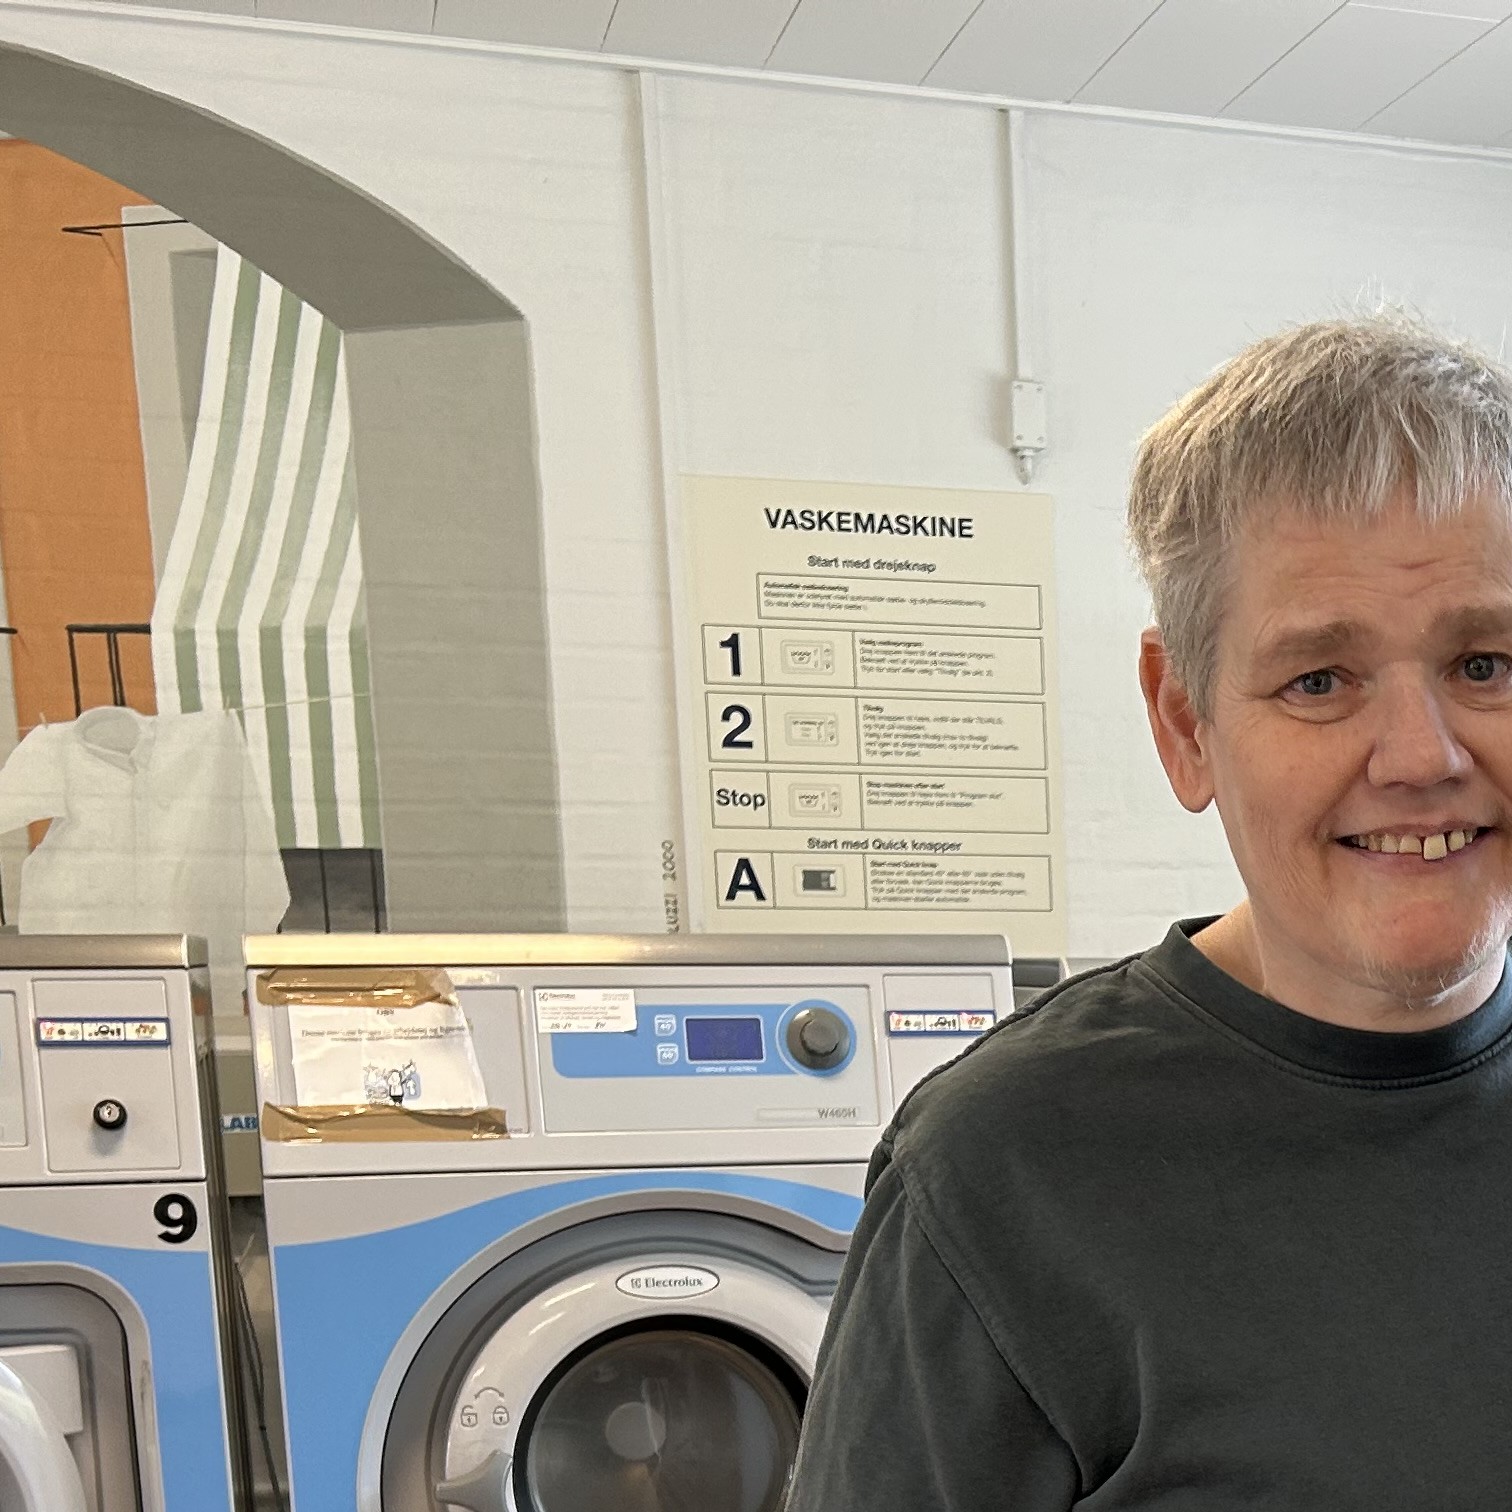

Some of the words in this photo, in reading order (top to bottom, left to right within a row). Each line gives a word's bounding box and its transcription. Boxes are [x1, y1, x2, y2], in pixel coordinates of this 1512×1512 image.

[764, 507, 975, 539] VASKEMASKINE
[807, 555, 839, 568] Start
[842, 558, 870, 570] med
[873, 559, 937, 574] drejeknap
[719, 632, 741, 678] 1
[720, 704, 754, 750] 2
[715, 788, 767, 811] Stop
[807, 838, 838, 849] Start
[841, 839, 869, 850] med
[872, 838, 908, 850] Quick
[911, 840, 962, 852] knapper
[725, 857, 767, 902] A
[154, 1194, 198, 1244] 9
[644, 1275, 703, 1289] Electrolux
